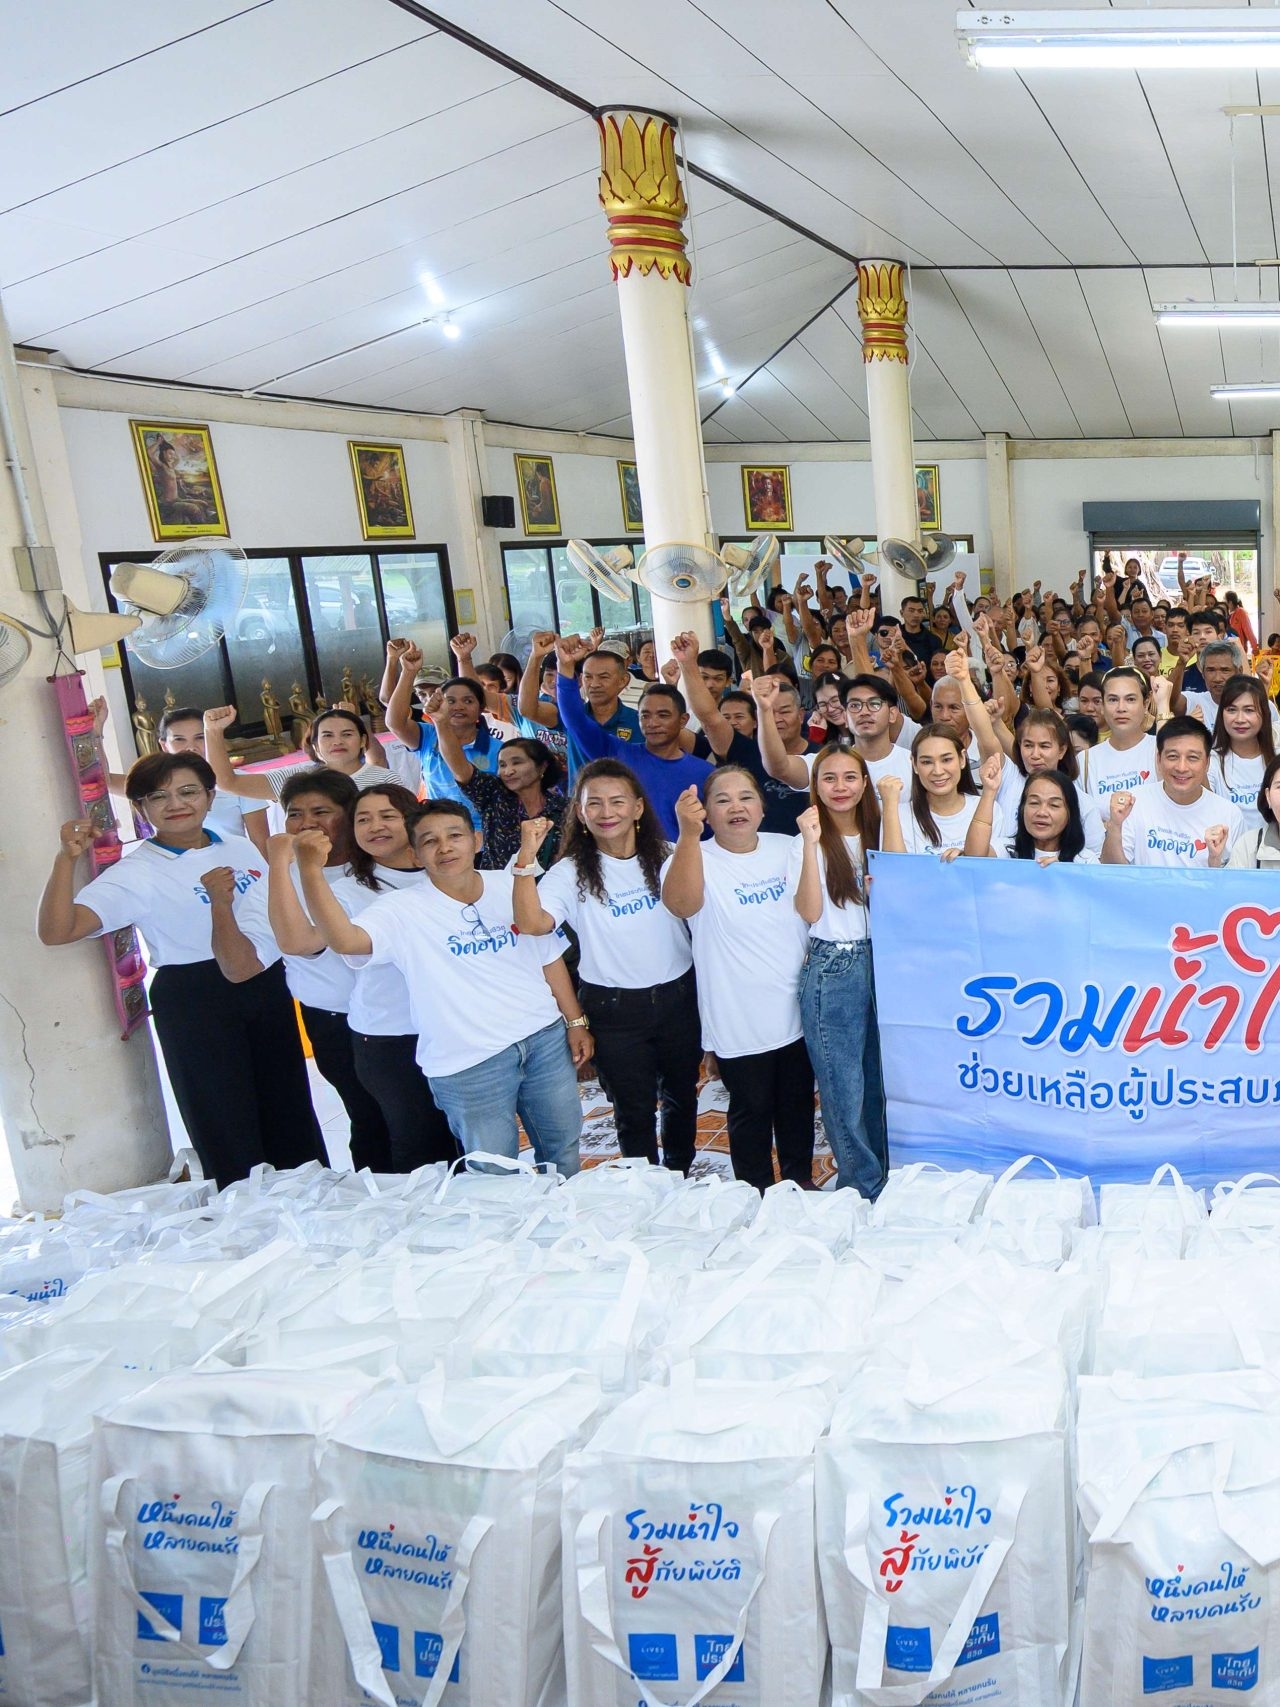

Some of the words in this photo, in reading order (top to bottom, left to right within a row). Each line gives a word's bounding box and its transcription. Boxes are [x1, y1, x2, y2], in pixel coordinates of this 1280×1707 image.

[625, 1503, 739, 1541] รวมน้ำใจ
[883, 1485, 991, 1529] รวมน้ำใจ
[625, 1544, 741, 1599] สู้ภัยพิบัติ
[880, 1530, 990, 1593] สู้ภัยพิบั
[1151, 1592, 1261, 1623] หลายคนรับ
[965, 1631, 996, 1648] ระกัน
[970, 1622, 989, 1636] ทย
